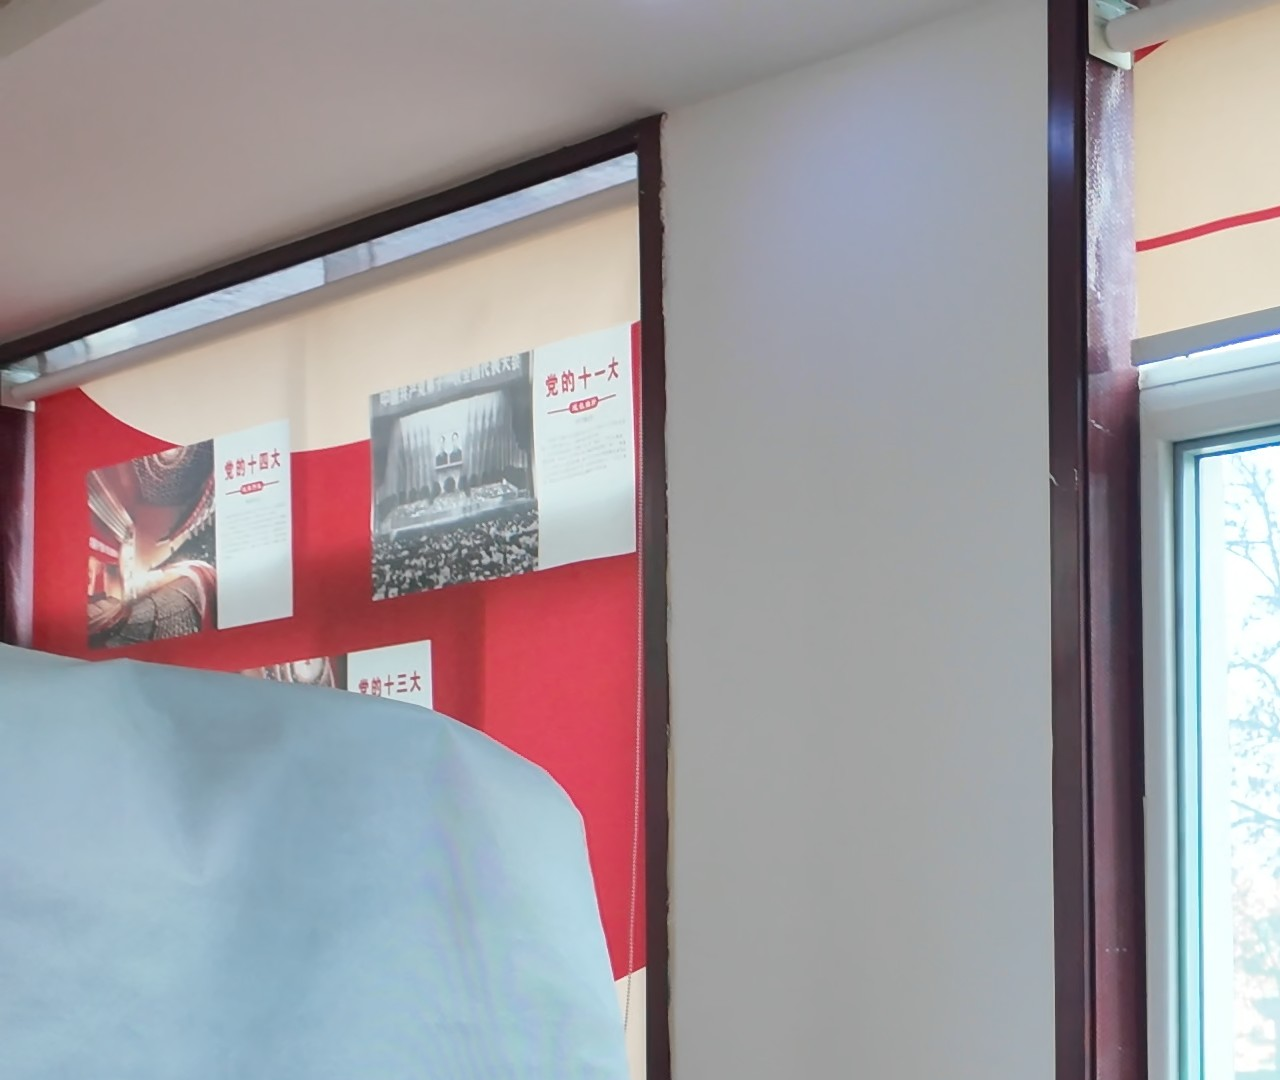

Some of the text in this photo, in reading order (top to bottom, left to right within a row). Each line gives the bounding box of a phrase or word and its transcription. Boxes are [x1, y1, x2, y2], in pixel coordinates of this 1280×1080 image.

[545, 356, 619, 397] 党的十一大
[224, 447, 281, 481] 党的十四大
[358, 669, 421, 698] 党的十三大
